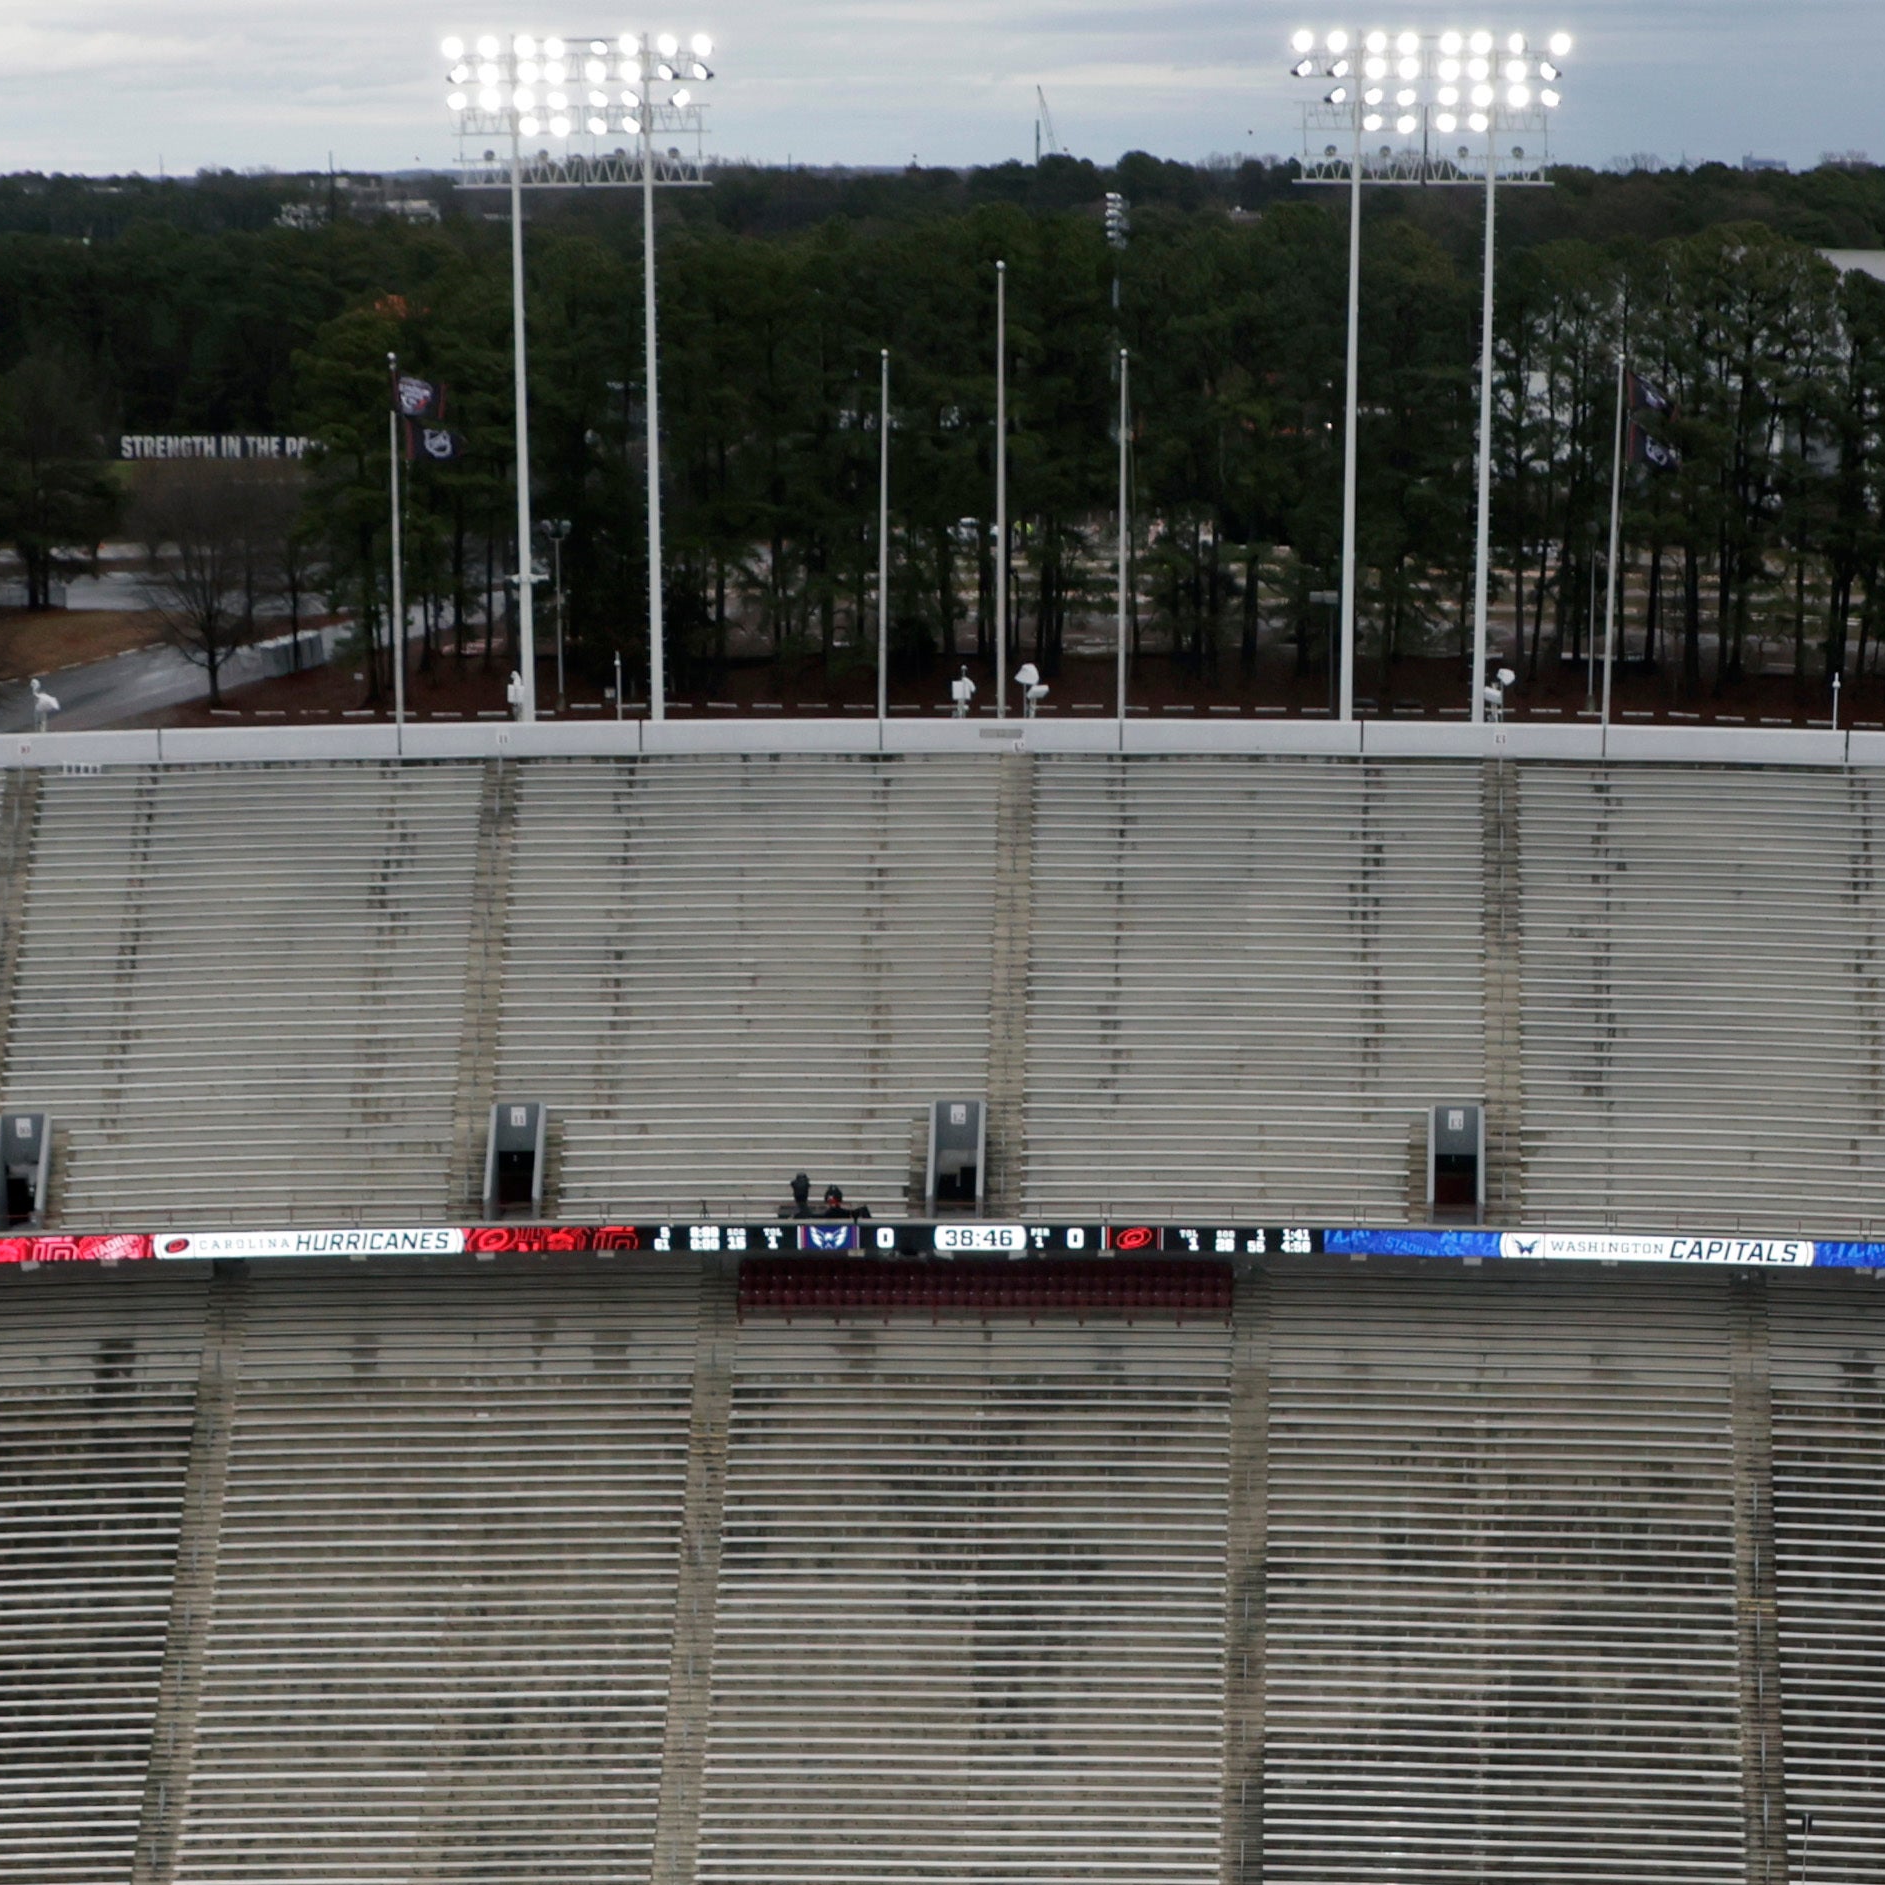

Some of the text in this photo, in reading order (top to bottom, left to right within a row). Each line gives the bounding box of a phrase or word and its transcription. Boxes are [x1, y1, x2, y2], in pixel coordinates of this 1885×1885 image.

[121, 436, 281, 459] STRENGTH IN THE
[199, 1233, 449, 1252] CAROLINA HURRICANES
[945, 1230, 1013, 1247] 38:46
[1551, 1240, 1798, 1264] WASHINGTON CAPITALS
